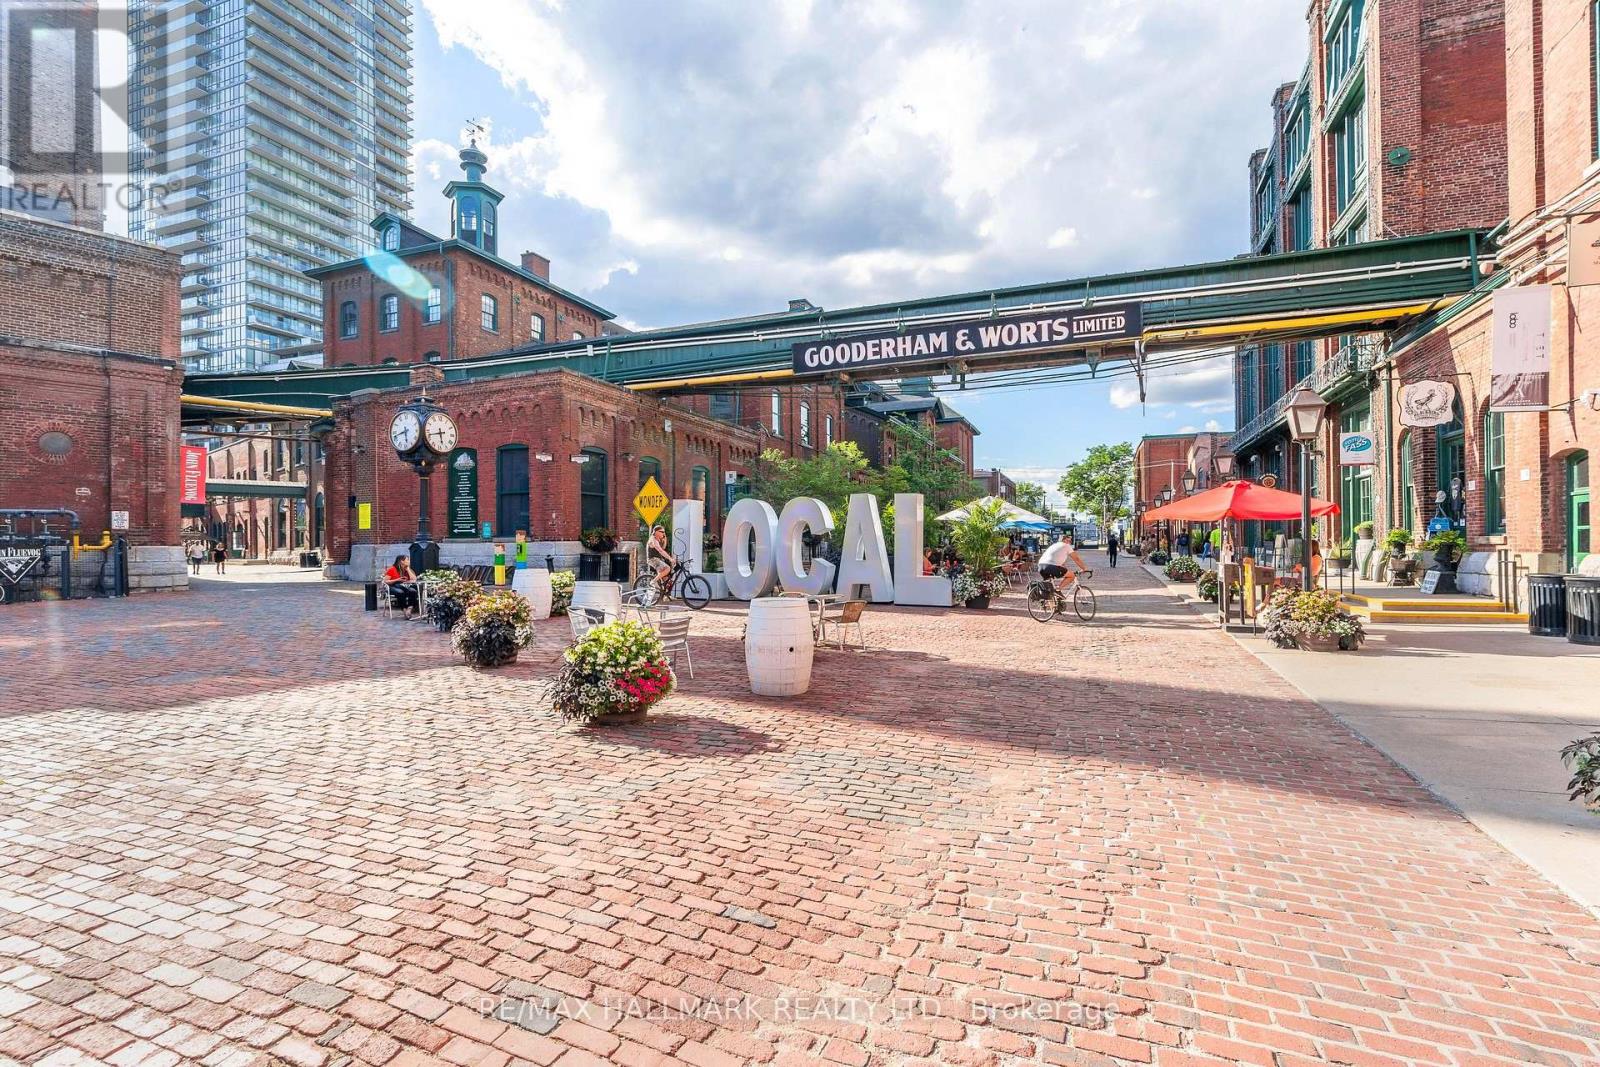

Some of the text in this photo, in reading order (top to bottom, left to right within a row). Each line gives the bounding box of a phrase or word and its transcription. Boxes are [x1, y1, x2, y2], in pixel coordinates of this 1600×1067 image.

[804, 315, 1126, 368] GOODERHAM & WORTS LIMITED
[638, 495, 664, 509] WONDER
[672, 493, 956, 607] LOCAL
